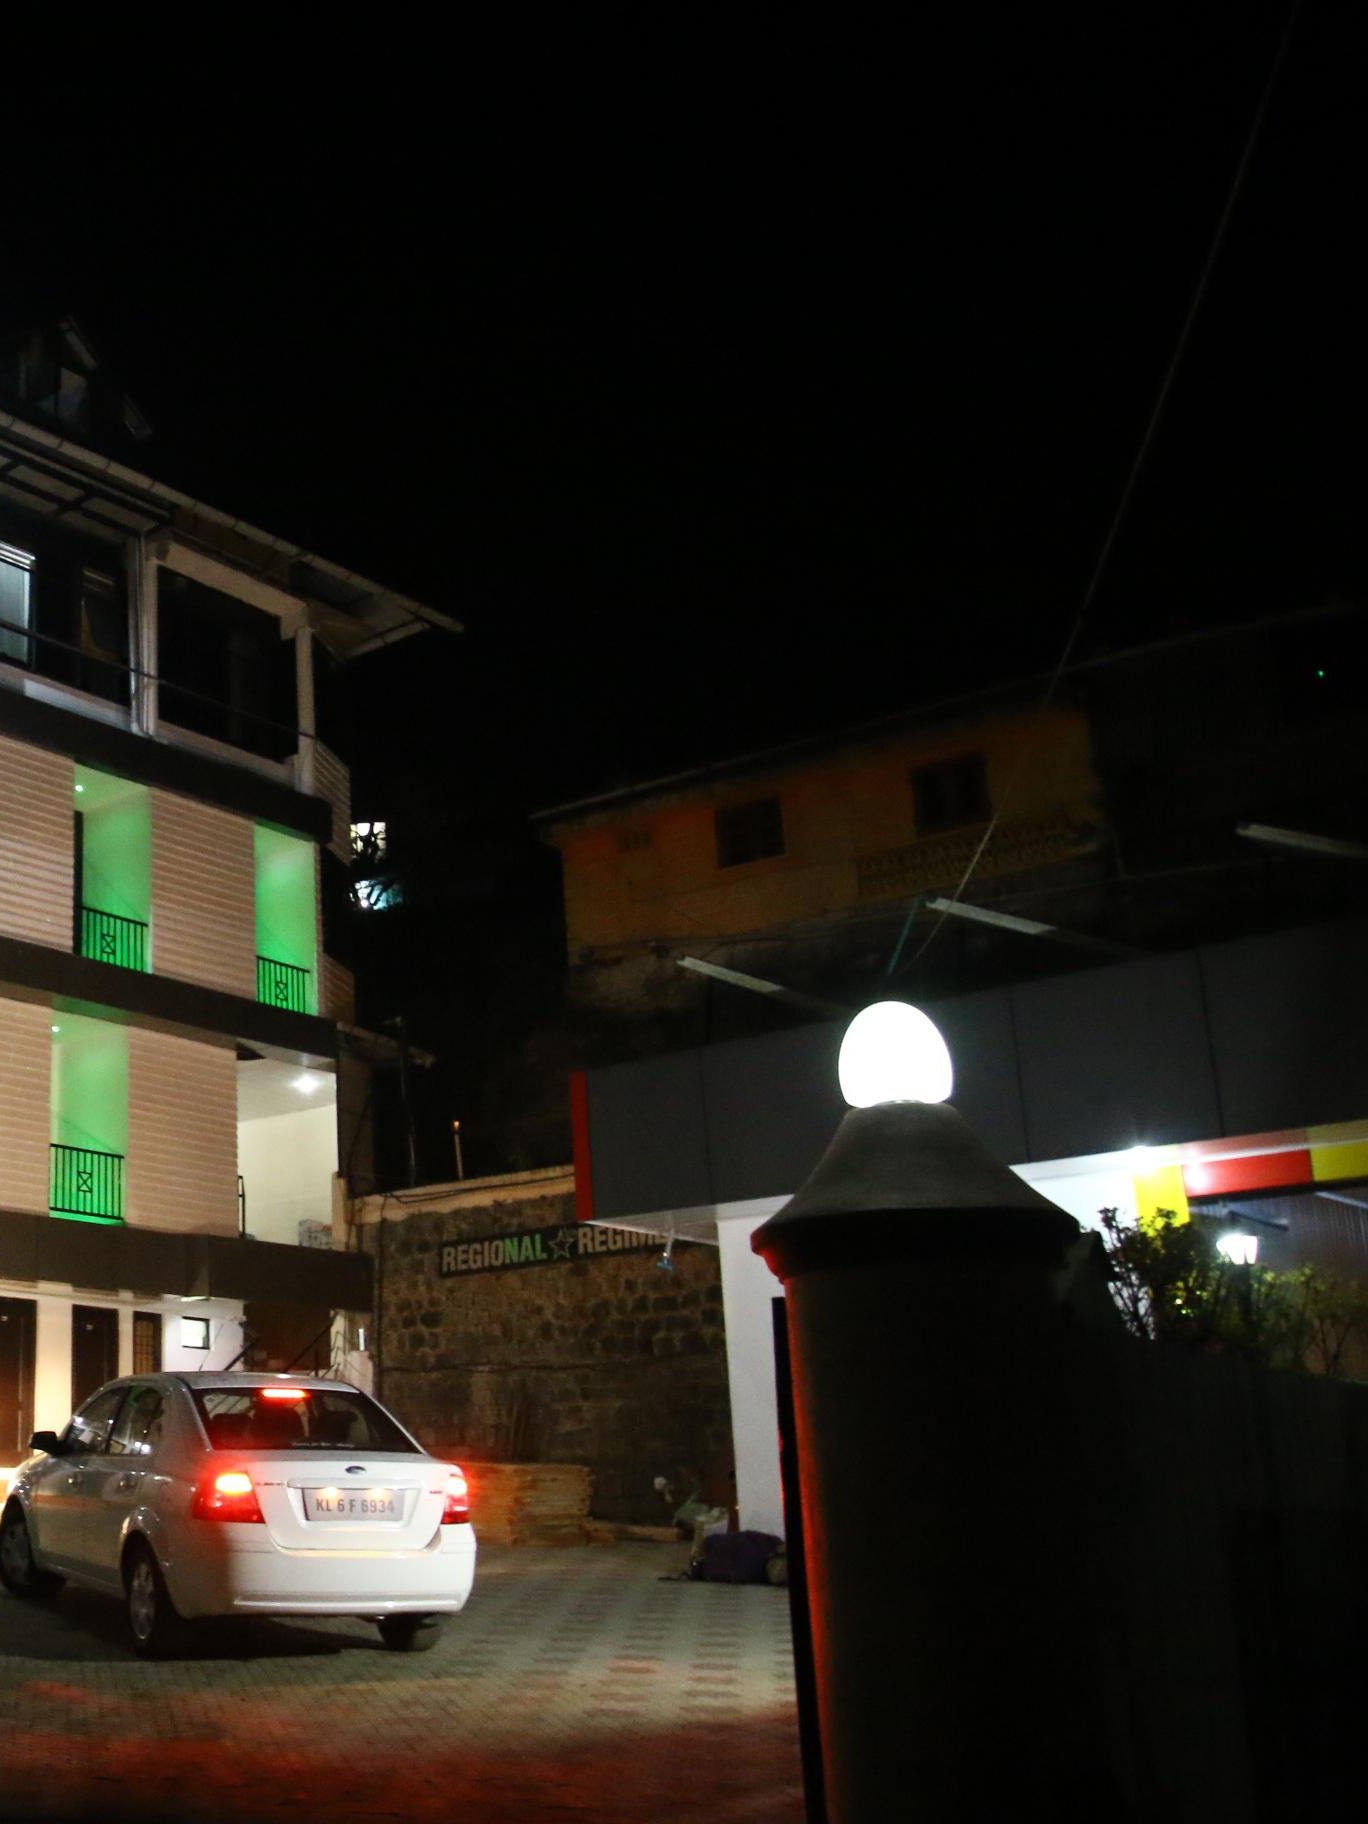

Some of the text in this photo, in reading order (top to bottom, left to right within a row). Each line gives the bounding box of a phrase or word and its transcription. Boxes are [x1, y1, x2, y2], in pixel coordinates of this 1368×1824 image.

[441, 1231, 549, 1273] REGIONAL
[316, 1498, 395, 1513] KL 6 F 6934
